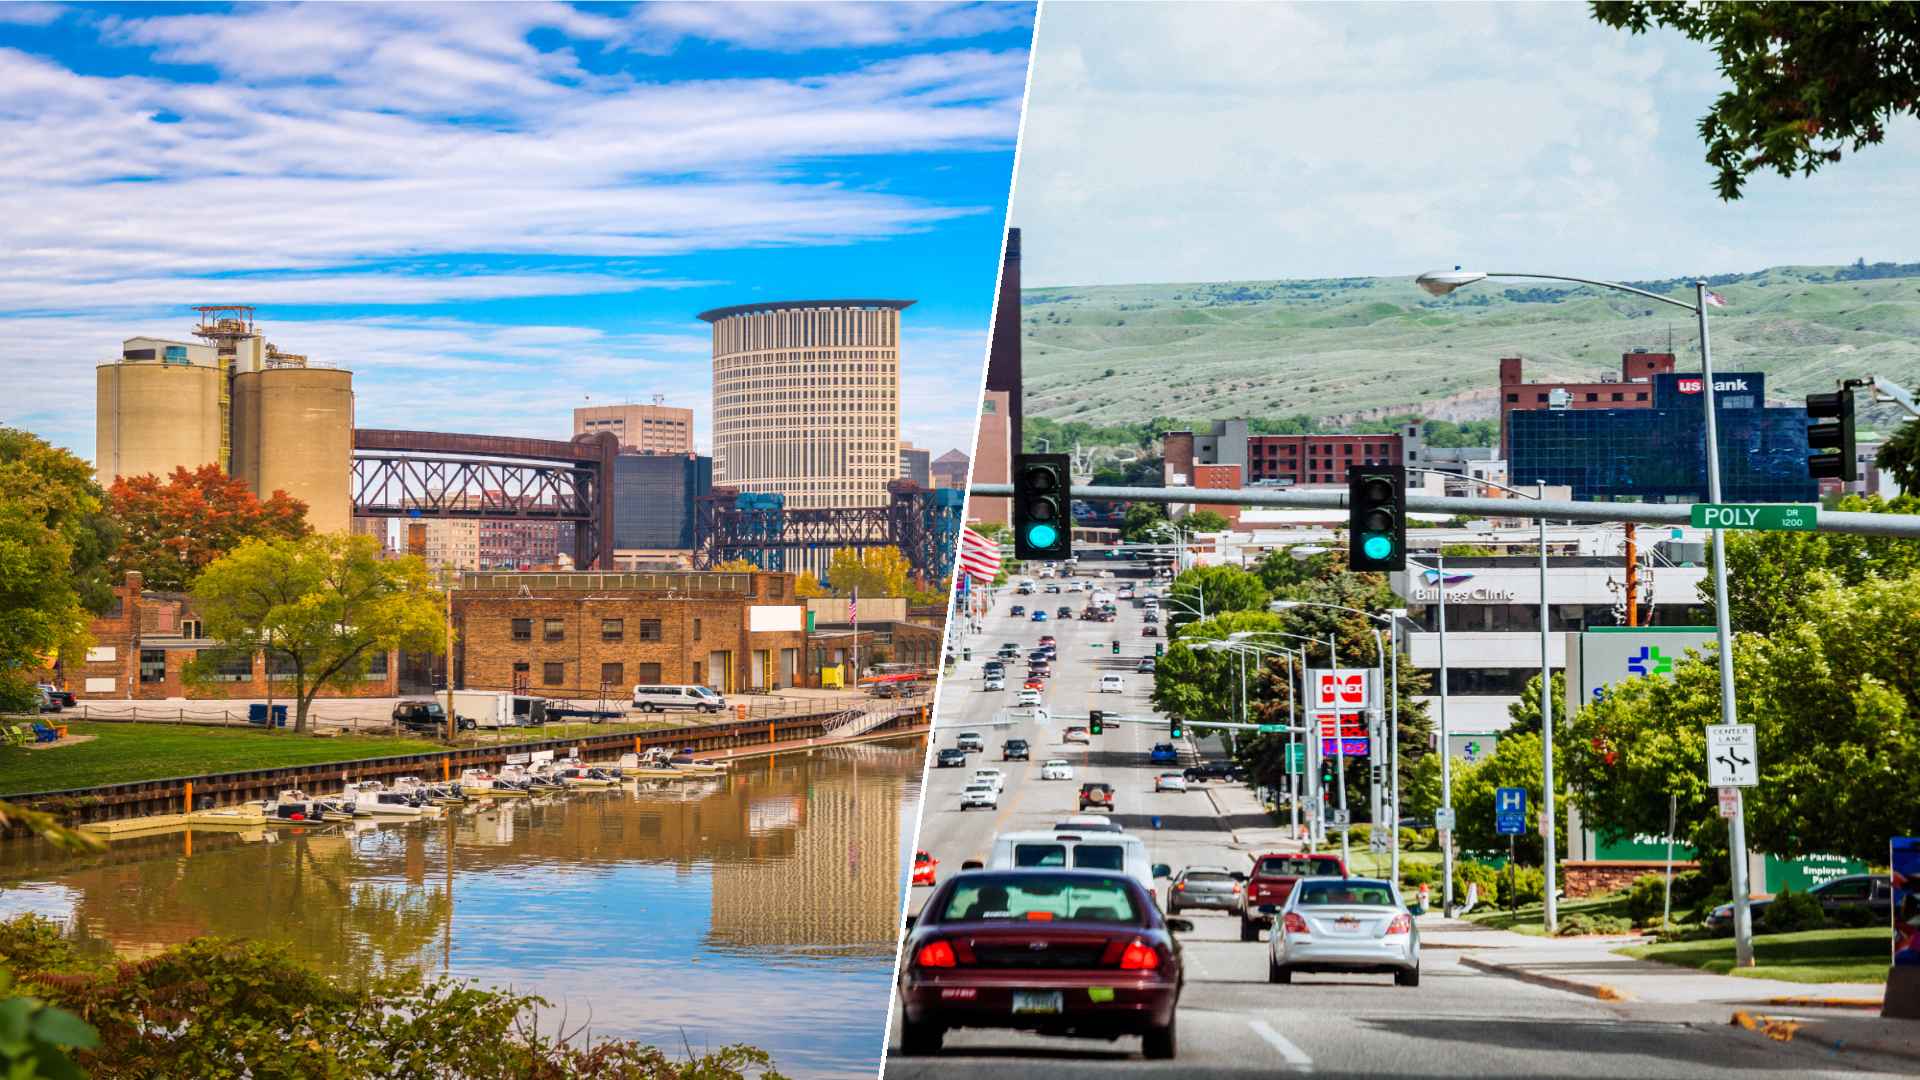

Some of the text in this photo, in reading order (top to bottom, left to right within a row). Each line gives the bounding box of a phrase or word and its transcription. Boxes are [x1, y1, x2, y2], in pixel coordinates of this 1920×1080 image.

[1705, 508, 1760, 525] POLY
[1786, 509, 1798, 517] DR
[1783, 519, 1803, 527] 1200
[1416, 586, 1514, 604] Billngs Clinic
[1503, 792, 1520, 810] H
[1810, 853, 1847, 863] Parking
[1803, 866, 1848, 876] Employee
